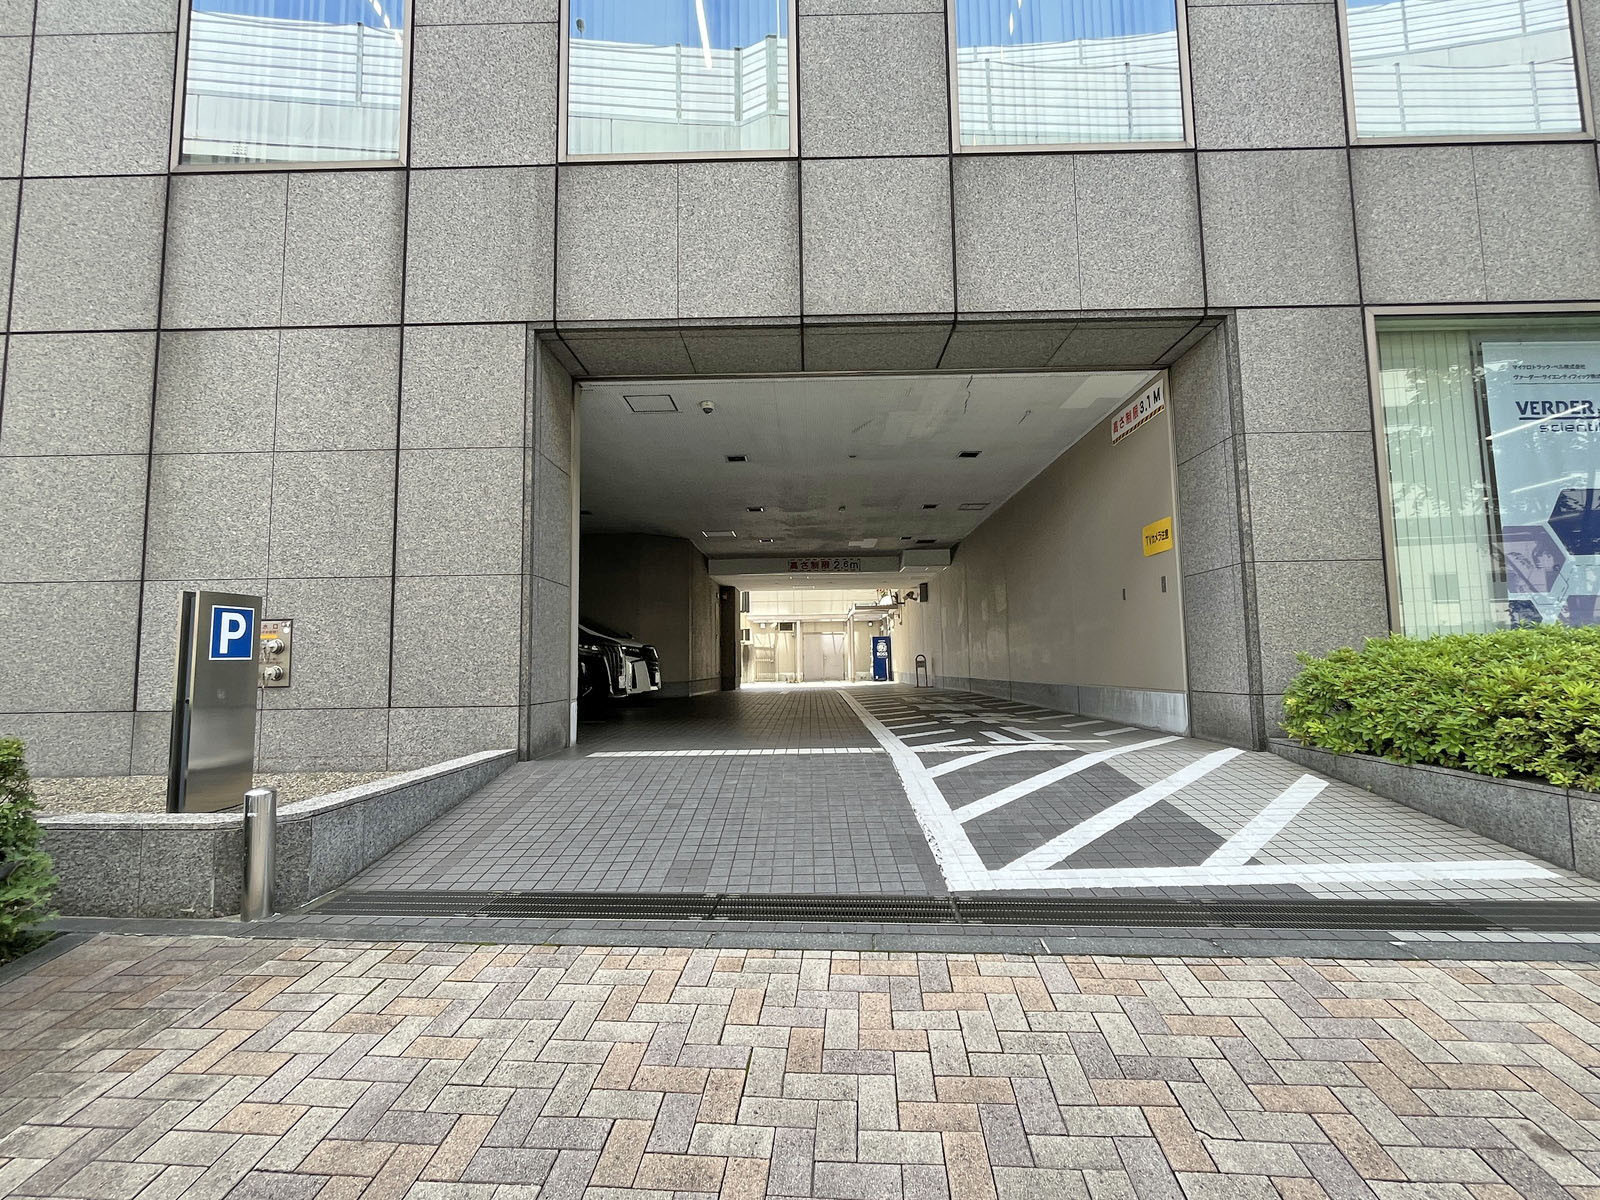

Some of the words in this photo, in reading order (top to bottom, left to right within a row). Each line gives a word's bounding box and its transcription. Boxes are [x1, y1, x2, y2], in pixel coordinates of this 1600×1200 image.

[1515, 400, 1595, 415] VERDER
[1540, 422, 1600, 433] scienti
[219, 611, 247, 654] P
